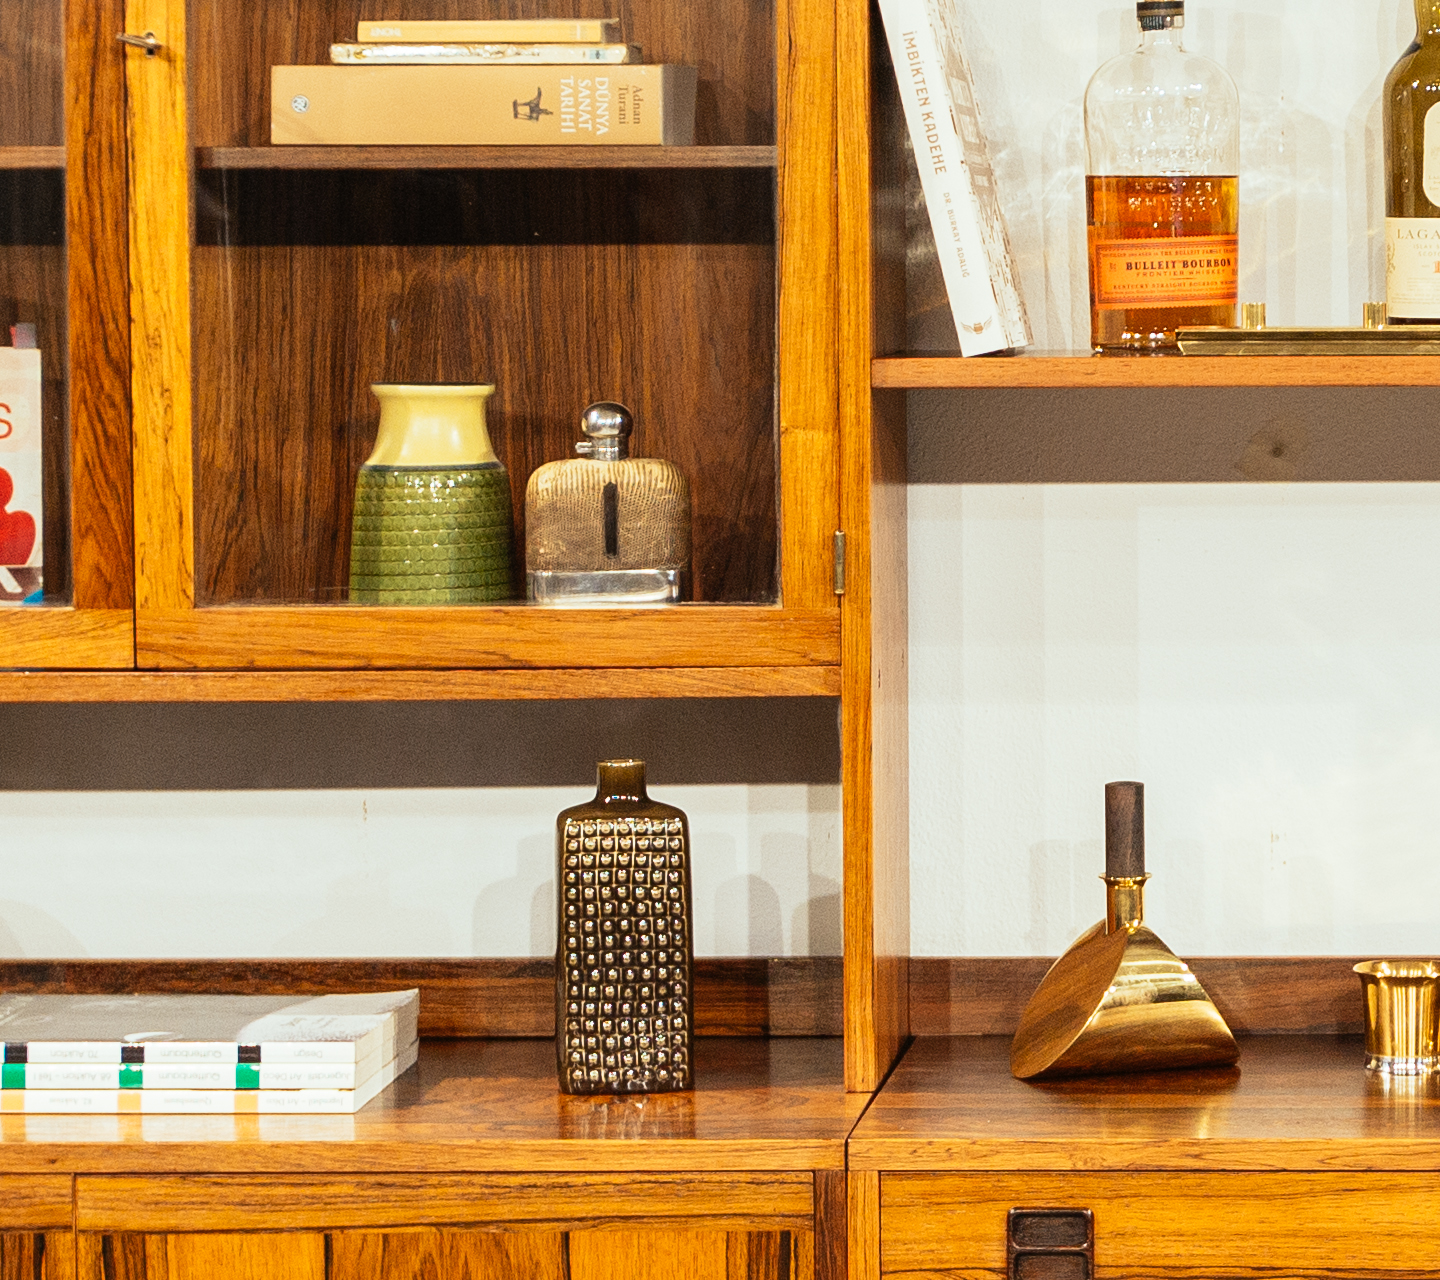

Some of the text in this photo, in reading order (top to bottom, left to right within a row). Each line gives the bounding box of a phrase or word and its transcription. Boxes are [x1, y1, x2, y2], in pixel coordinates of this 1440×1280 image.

[578, 79, 592, 131] SANAT
[595, 77, 611, 135] DÜNYA
[618, 85, 629, 125] Turani
[633, 85, 644, 125] Adnan
[902, 30, 947, 175] İMBİKTEN KADEHE
[942, 192, 951, 207] DR.
[947, 208, 961, 243] BURKAY
[1126, 258, 1231, 271] BULLEIT BOURBON
[49, 1050, 84, 1058] Auktion
[160, 1049, 221, 1058] Quittenbaum
[293, 1048, 323, 1058] Design
[62, 1072, 96, 1080] Auktion
[158, 1071, 220, 1080] Quittenbaum
